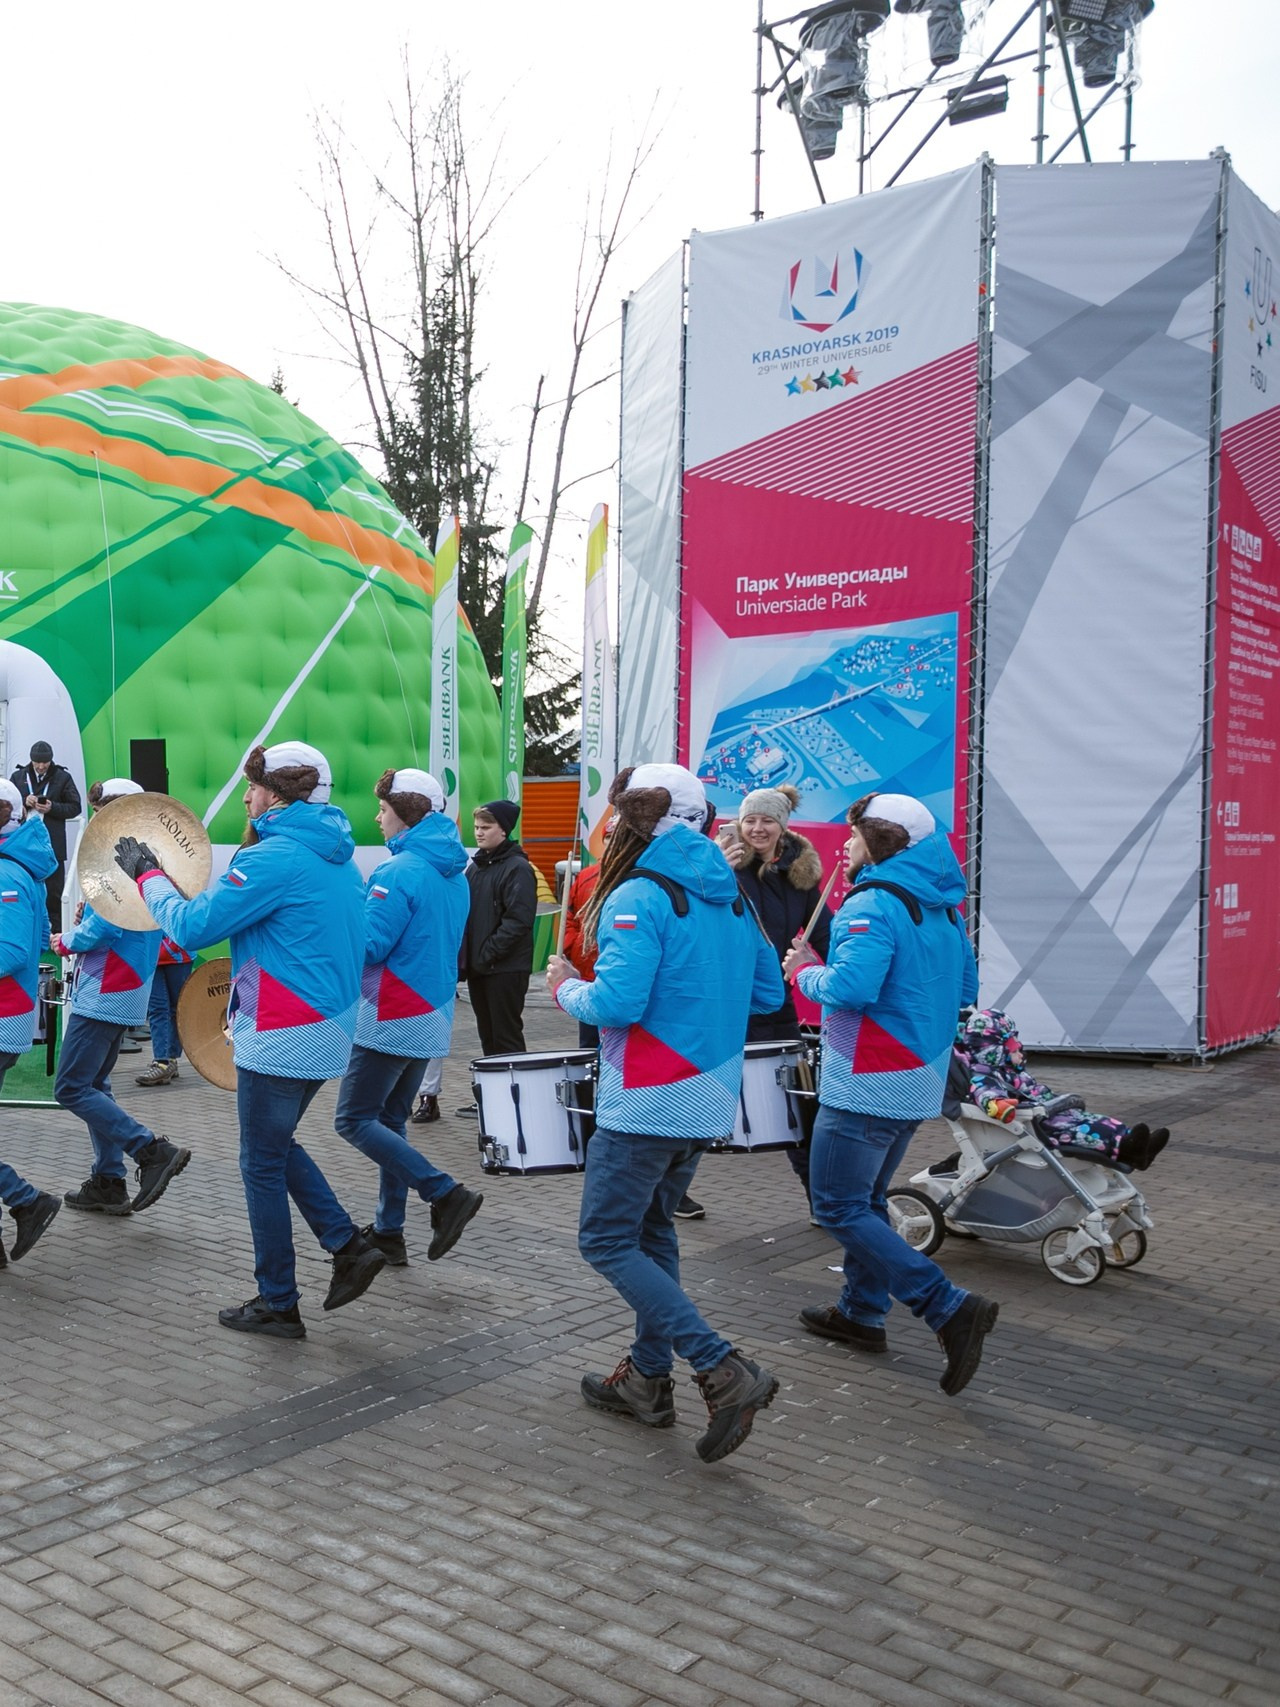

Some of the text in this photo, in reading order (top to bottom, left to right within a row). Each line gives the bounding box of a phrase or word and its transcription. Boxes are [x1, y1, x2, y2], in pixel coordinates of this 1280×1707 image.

[752, 325, 899, 364] KRASNOYARSK 2019
[780, 356, 819, 371] WINTER
[822, 342, 892, 364] UNIVERSIADE
[1250, 364, 1267, 393] FISU
[736, 565, 908, 595] Парк Универсиады
[736, 590, 868, 617] Universiade Park
[442, 646, 451, 760] SBERBANK
[586, 638, 602, 759] SBERBANK
[157, 812, 196, 858] RADIANT
[207, 983, 232, 998] BIAN
